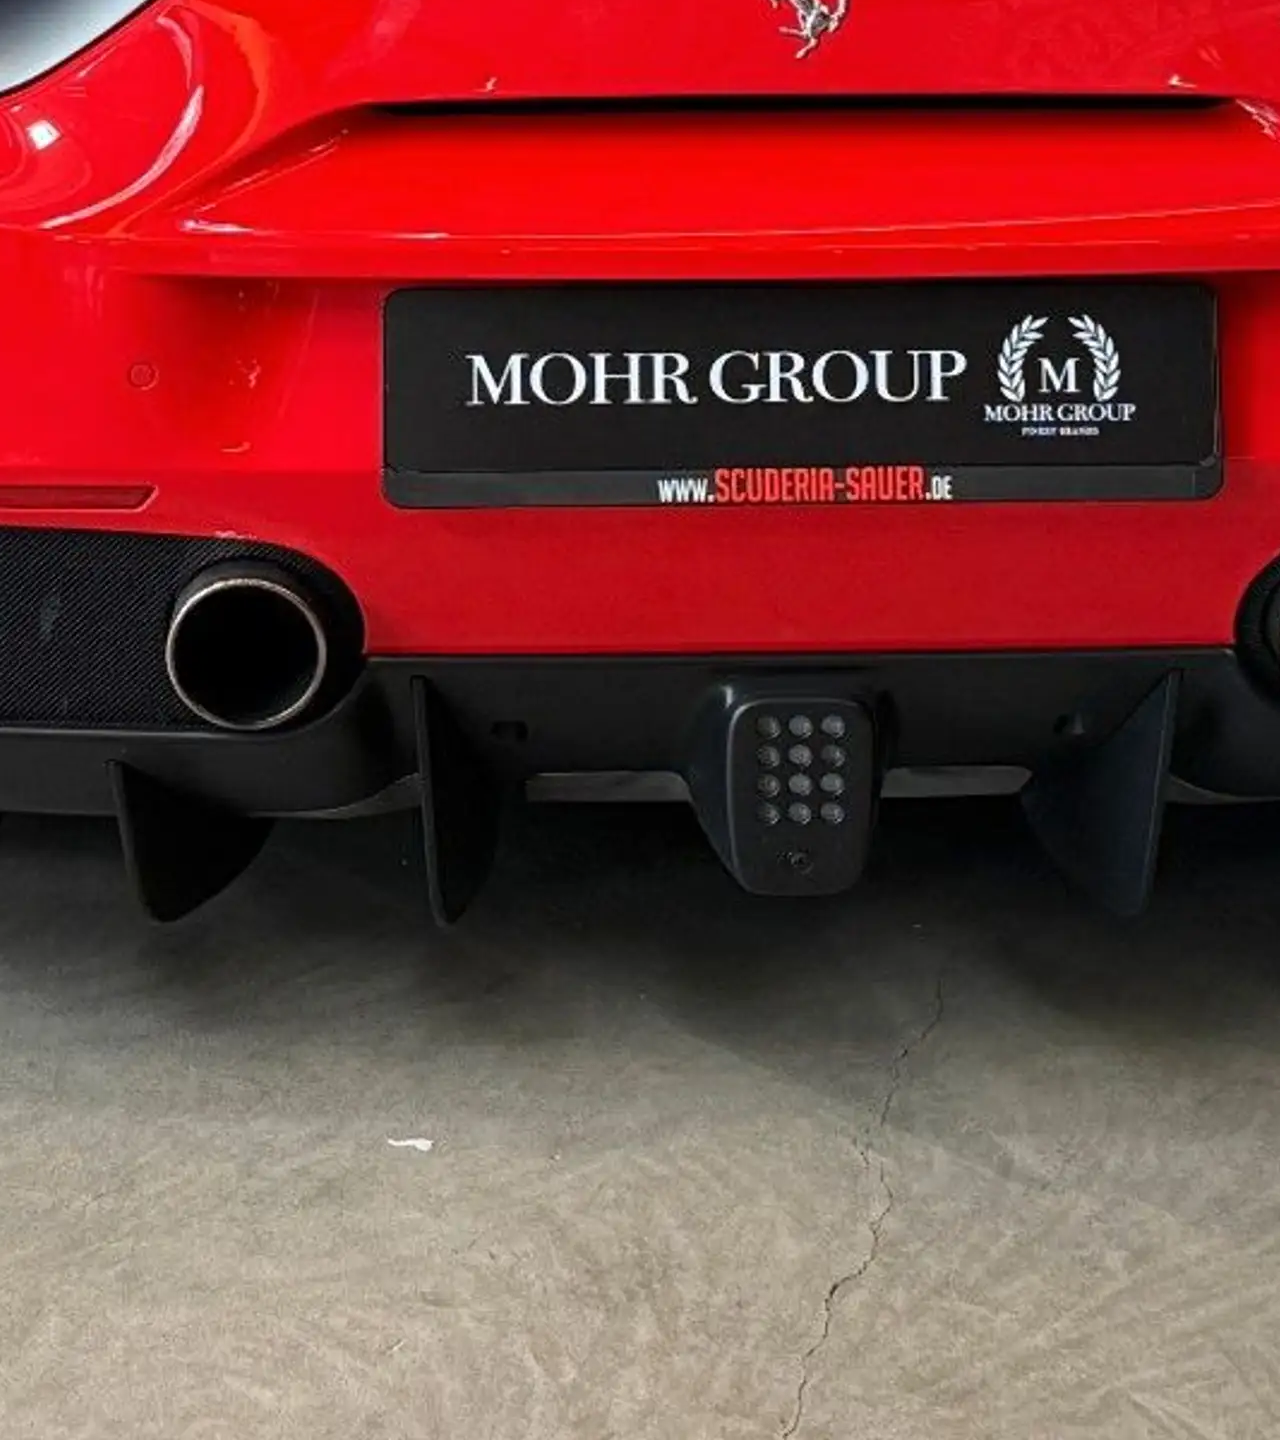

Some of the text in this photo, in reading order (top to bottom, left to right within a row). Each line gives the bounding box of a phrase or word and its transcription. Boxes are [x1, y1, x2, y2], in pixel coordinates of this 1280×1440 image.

[465, 349, 969, 407] MOHR GROUP
[1036, 357, 1082, 393] M
[983, 403, 1137, 423] MOHR GROUP
